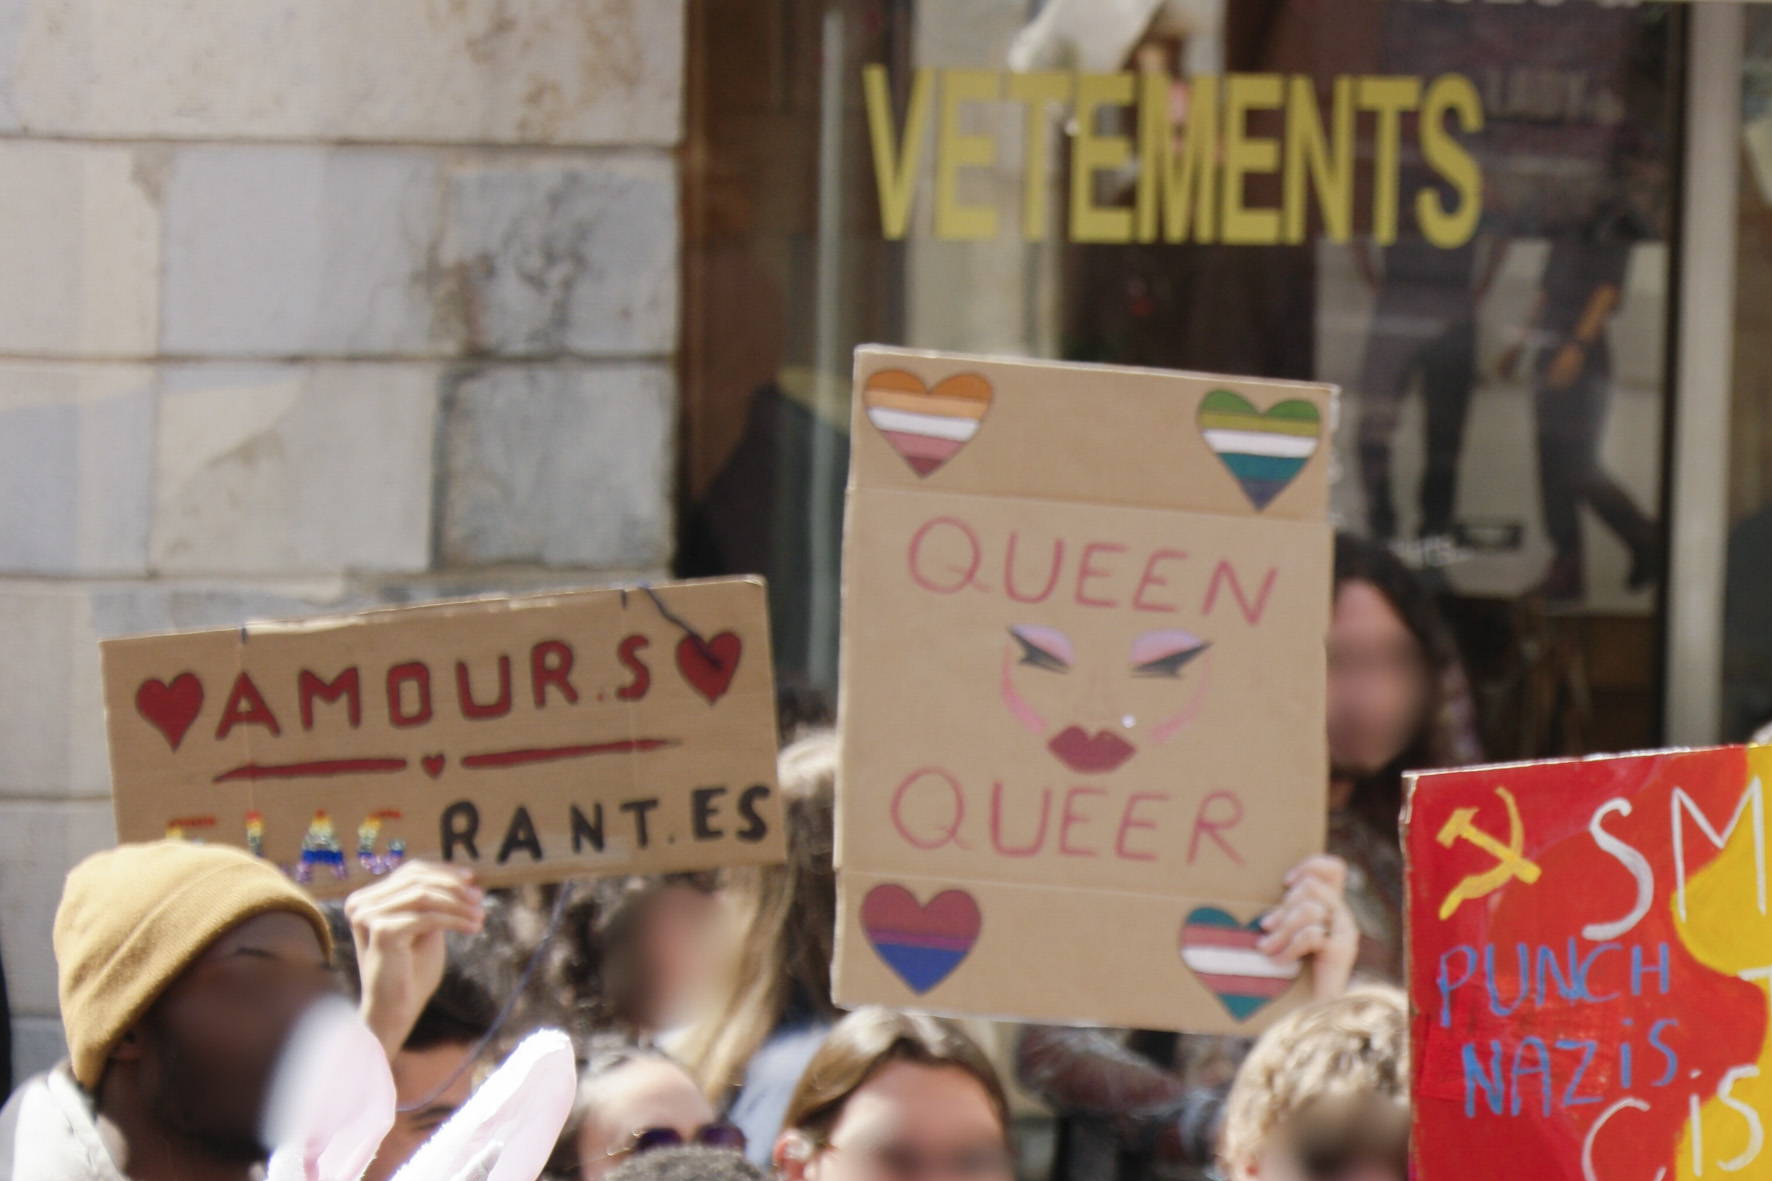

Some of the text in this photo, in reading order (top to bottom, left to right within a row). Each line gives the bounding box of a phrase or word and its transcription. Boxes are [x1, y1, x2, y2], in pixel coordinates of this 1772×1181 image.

[863, 64, 1485, 249] VETEMENTS
[907, 515, 1280, 626] QUEEN
[890, 765, 1247, 867] QUEER
[1436, 936, 1671, 1028] PUNCH
